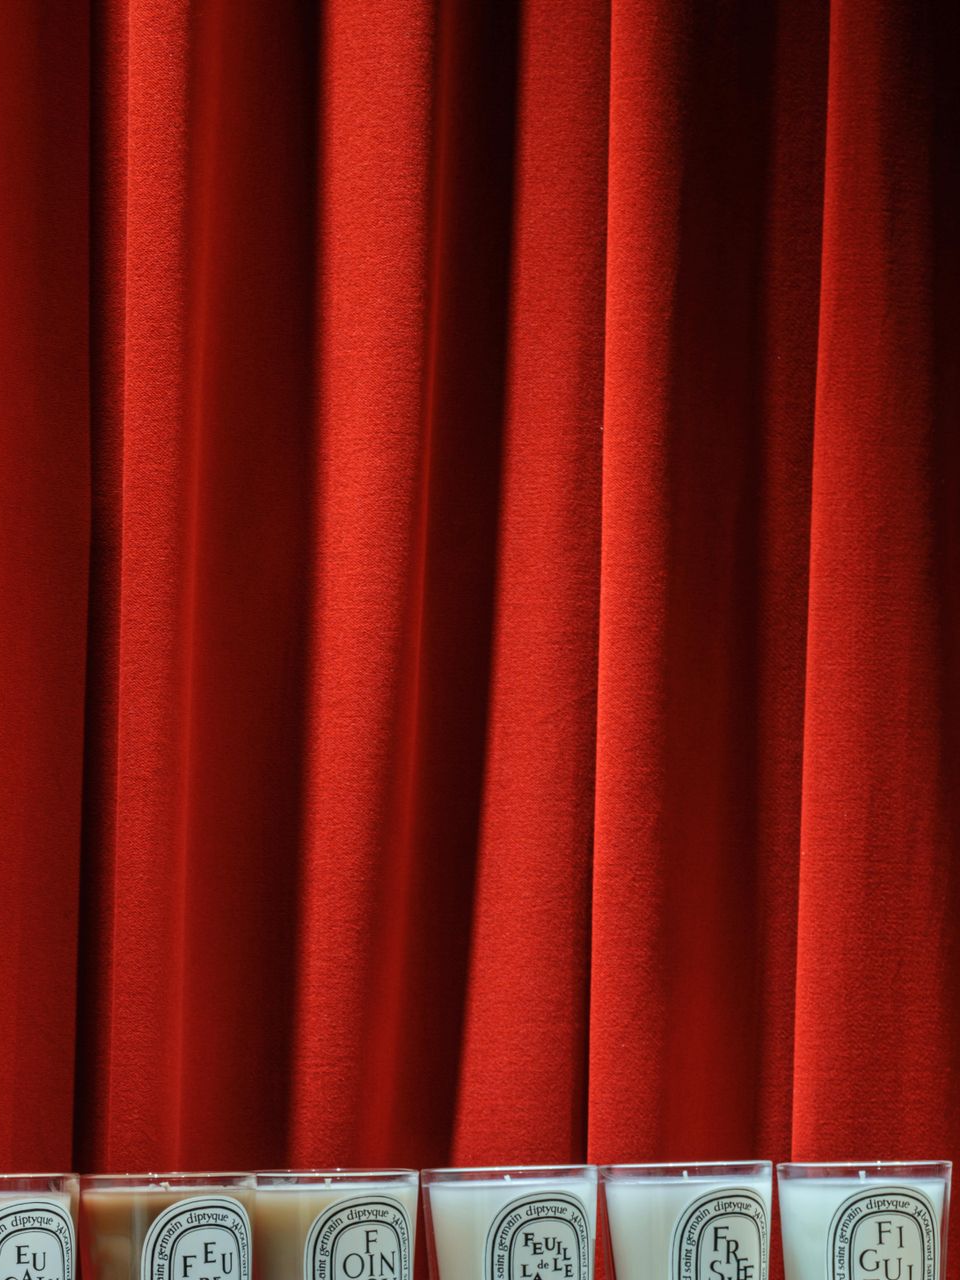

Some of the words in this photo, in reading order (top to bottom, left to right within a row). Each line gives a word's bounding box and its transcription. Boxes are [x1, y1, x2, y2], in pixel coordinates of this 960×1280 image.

[525, 1204, 569, 1217] diptyque
[713, 1201, 752, 1214] diptyque
[186, 1212, 230, 1226] diptyque
[346, 1208, 390, 1222] diptyque
[840, 1206, 863, 1244] germain
[866, 1198, 911, 1211] diptyque
[11, 1215, 54, 1230] diptyque
